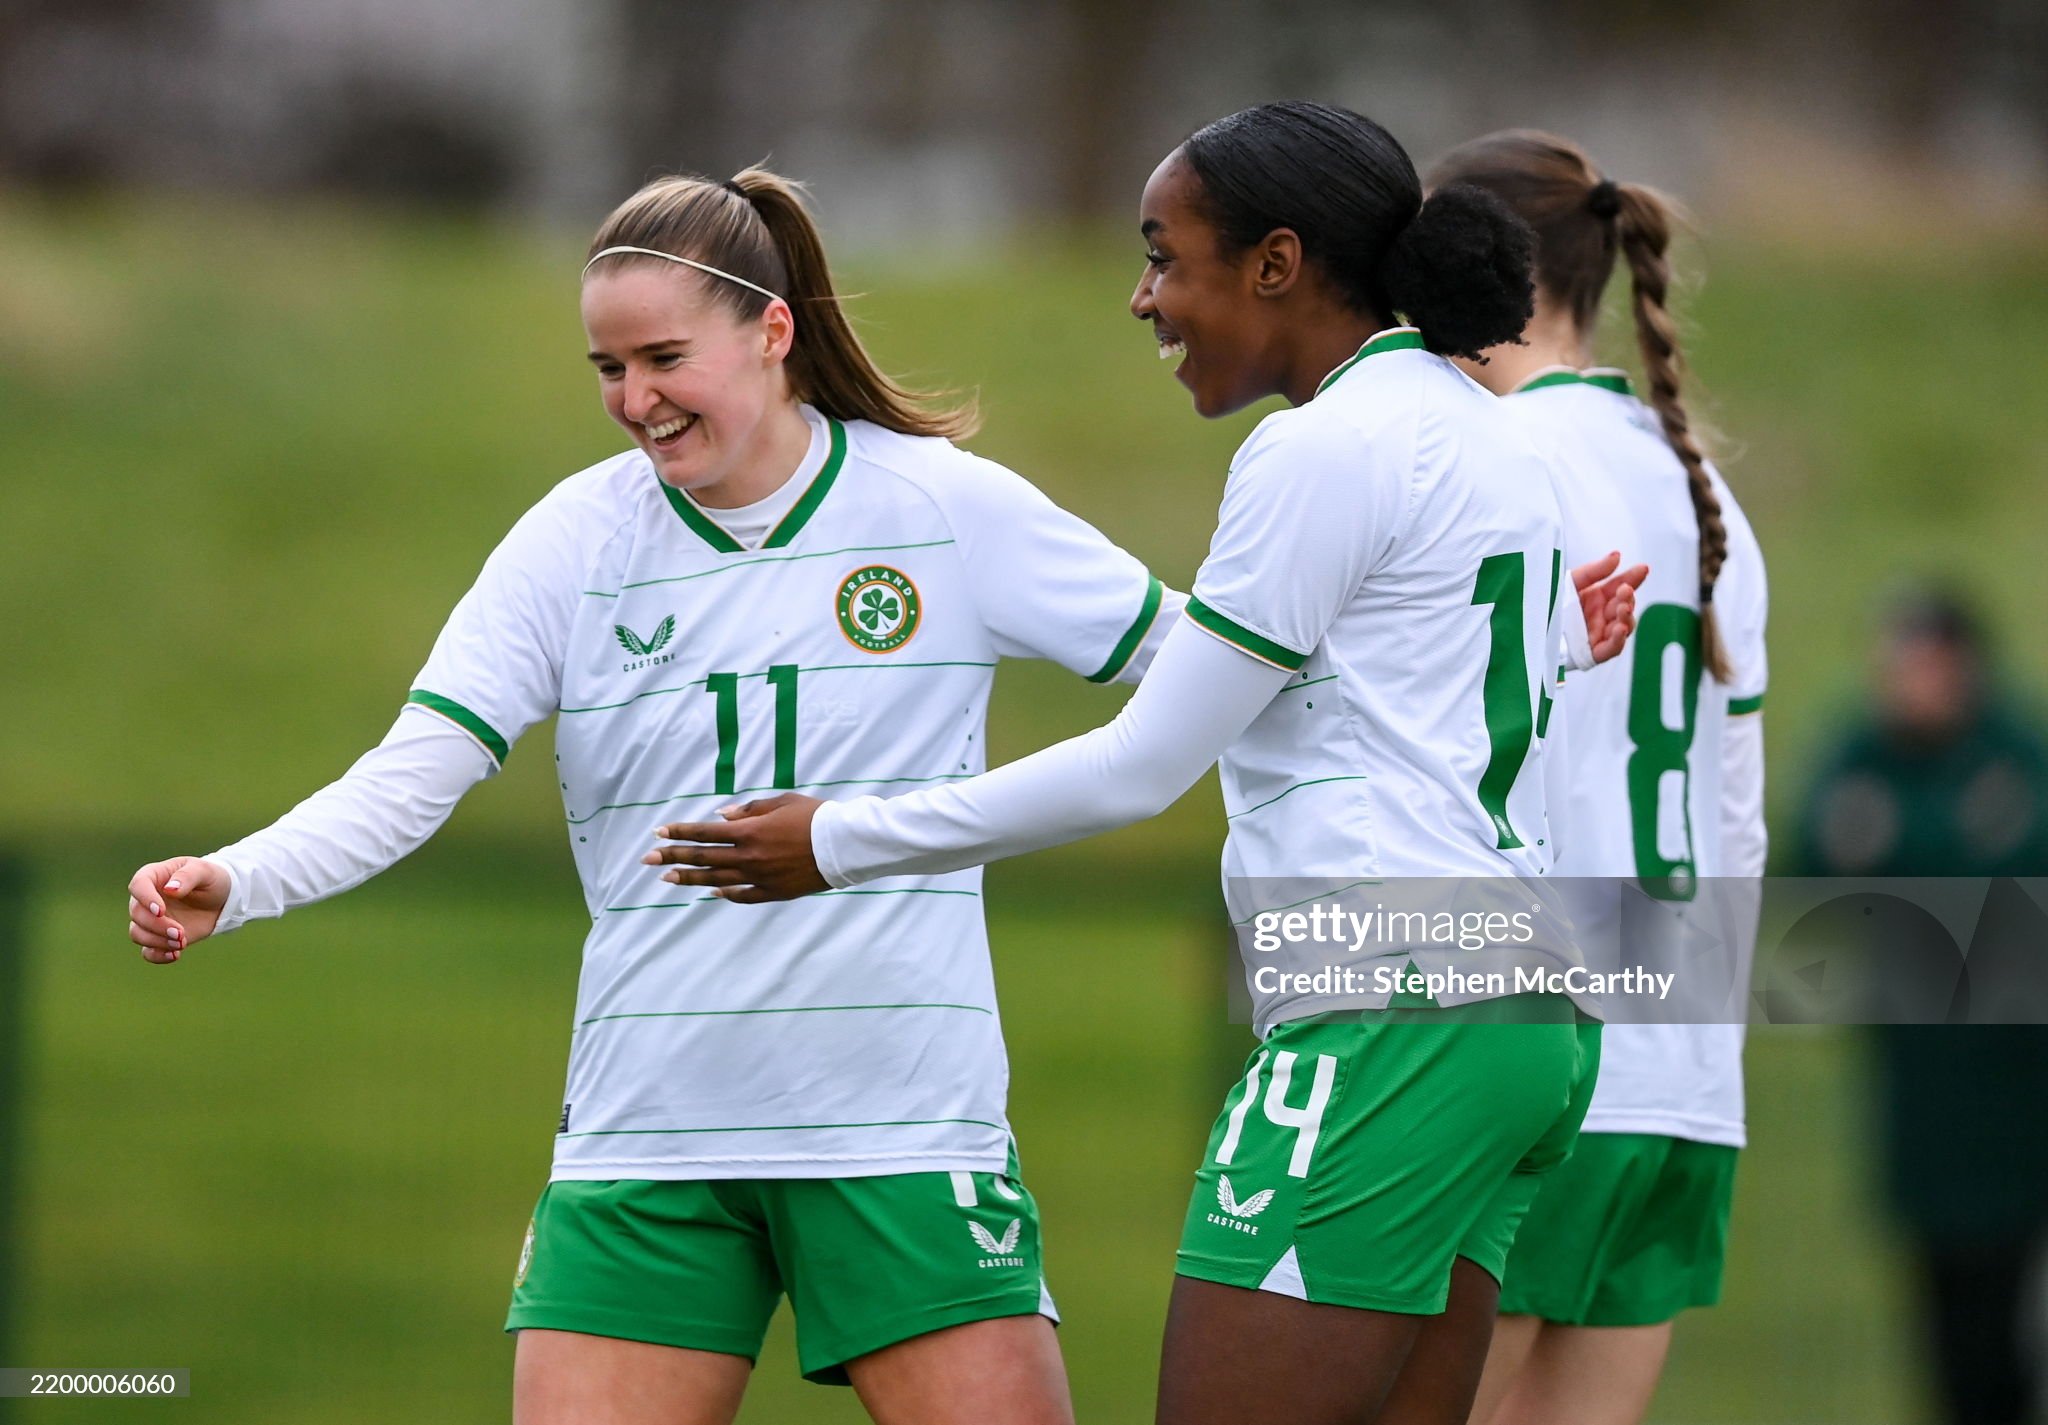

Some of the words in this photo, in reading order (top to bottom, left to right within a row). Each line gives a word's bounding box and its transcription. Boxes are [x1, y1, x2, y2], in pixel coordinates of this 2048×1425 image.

[841, 570, 913, 598] IRELAND
[853, 633, 906, 649] FOOTBALL
[705, 664, 799, 796] 11
[1627, 603, 1702, 902] 8
[1214, 1049, 1338, 1179] 14
[1207, 1213, 1259, 1236] CASTORE
[978, 1258, 1024, 1268] CASTORE
